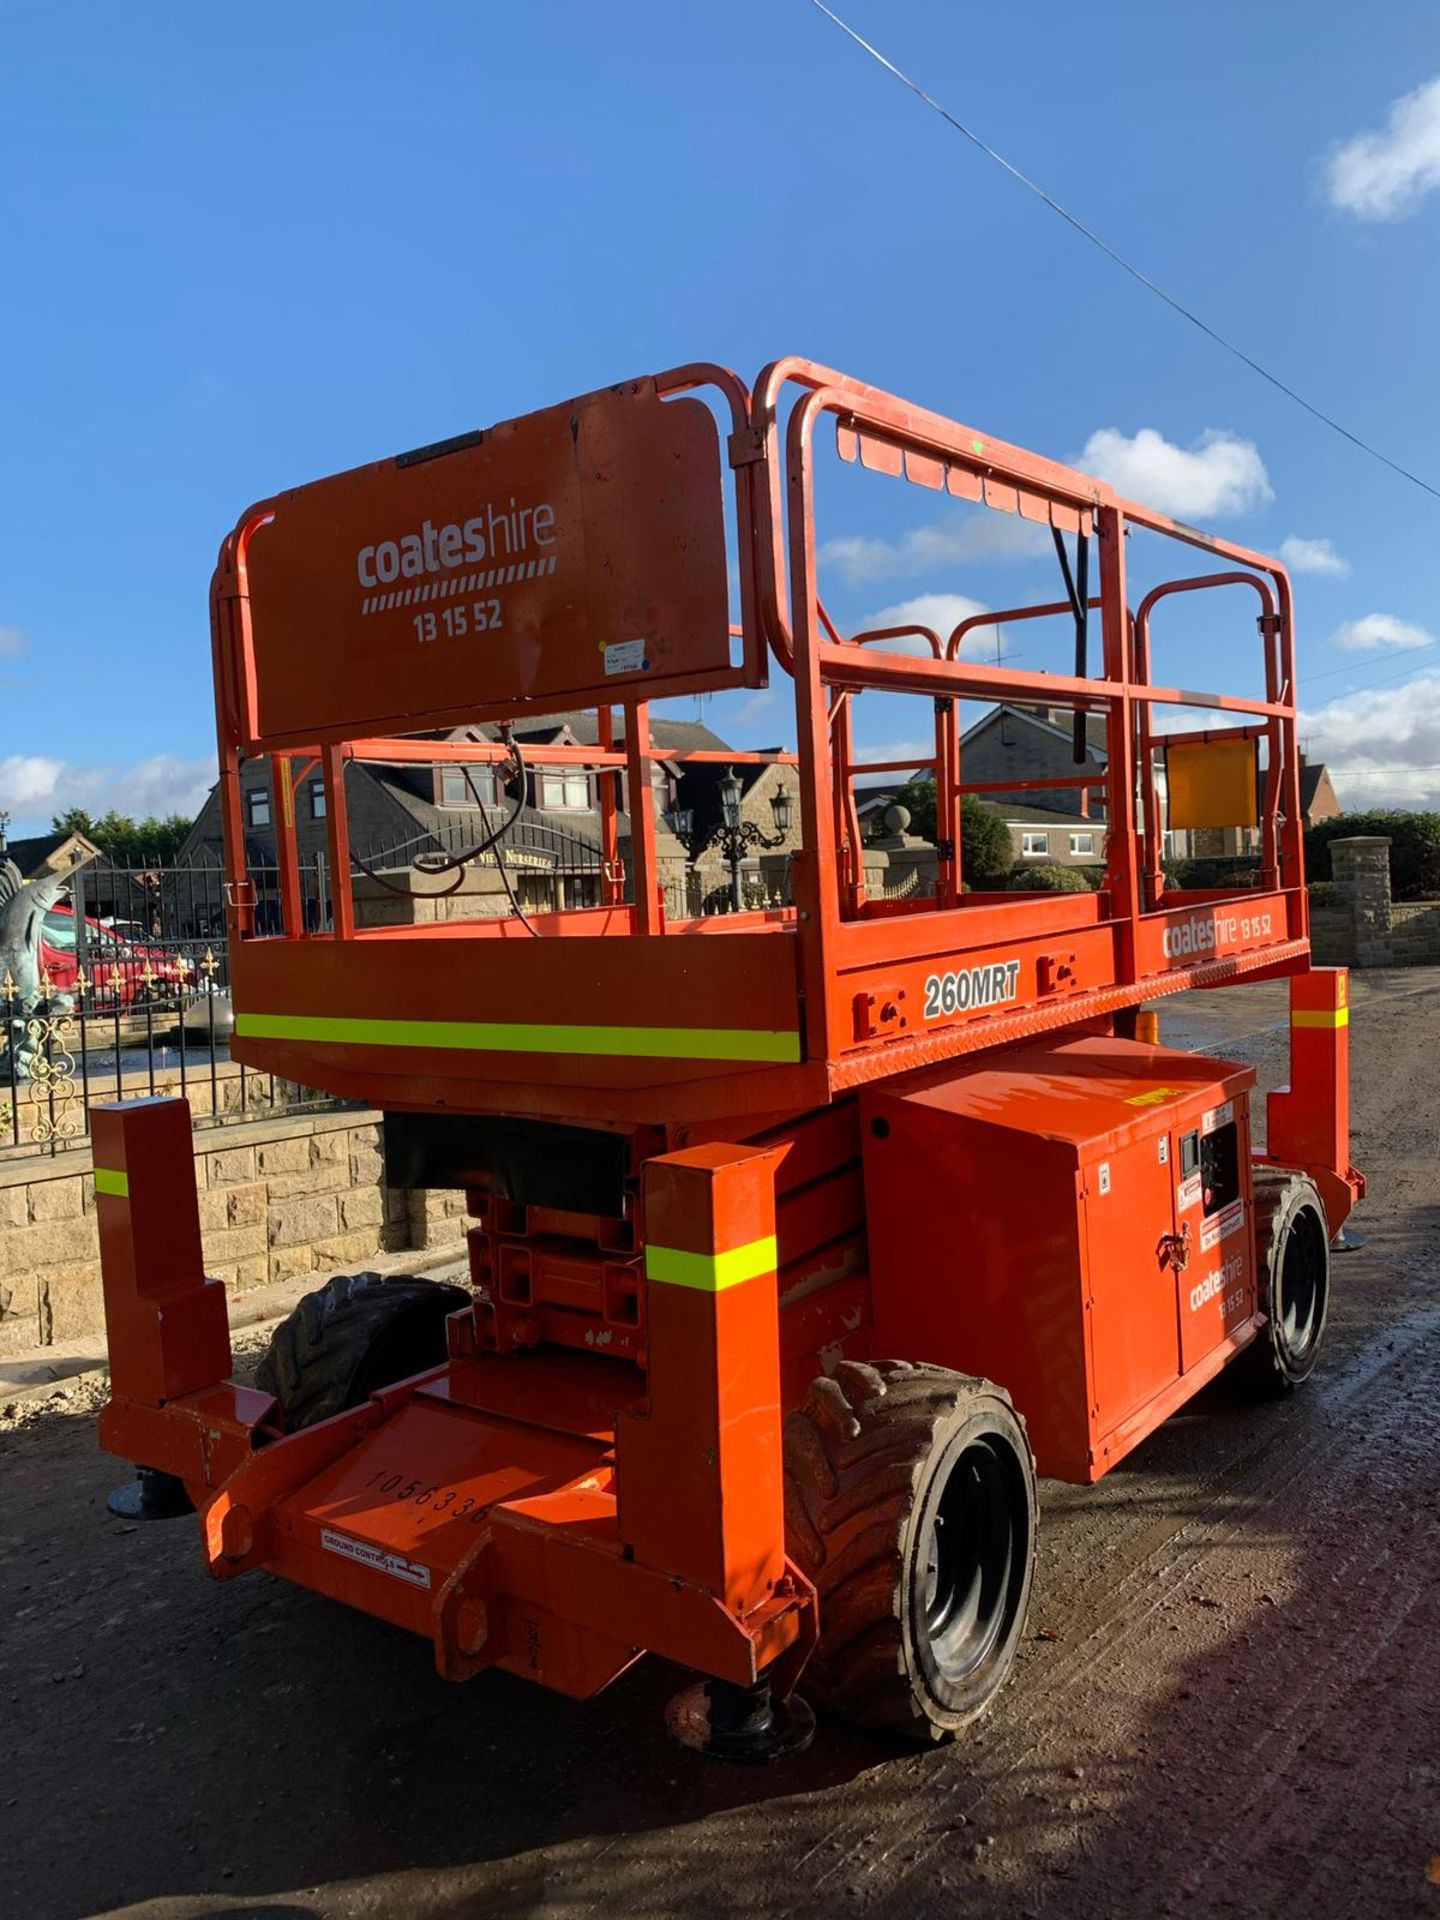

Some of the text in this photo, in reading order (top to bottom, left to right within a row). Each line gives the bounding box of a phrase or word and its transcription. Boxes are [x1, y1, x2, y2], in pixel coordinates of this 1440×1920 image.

[357, 497, 556, 588] coateshire
[412, 599, 503, 642] 13 15 52
[1240, 918, 1250, 940] 13
[1251, 916, 1261, 937] 15
[1261, 914, 1272, 936] 52
[925, 960, 1020, 1018] 260MRT
[366, 1470, 492, 1524] 1056336
[324, 1535, 354, 1553] GROUND
